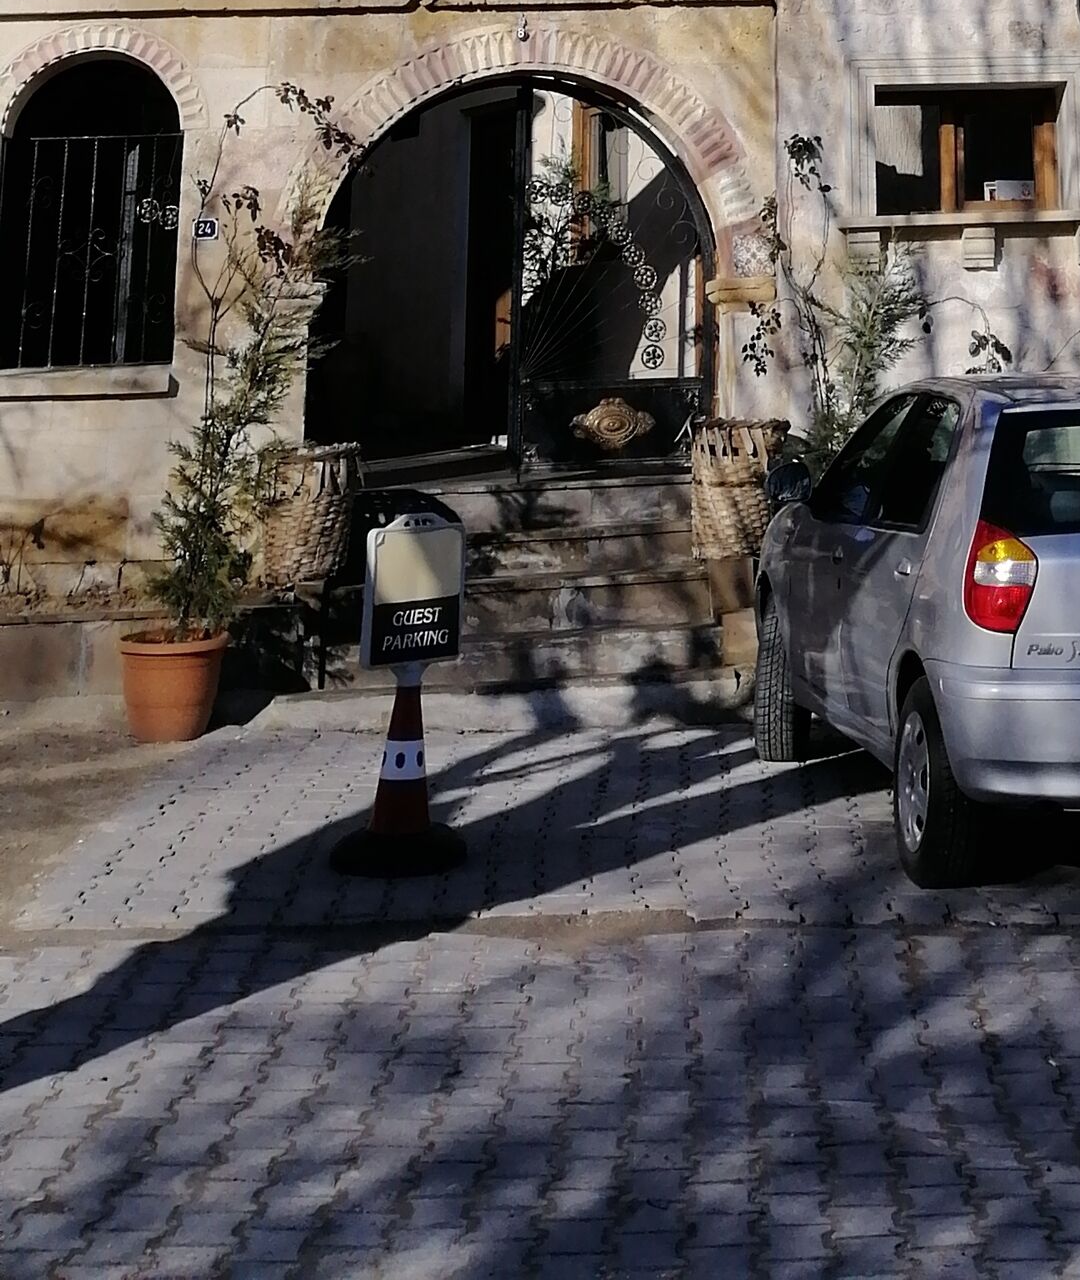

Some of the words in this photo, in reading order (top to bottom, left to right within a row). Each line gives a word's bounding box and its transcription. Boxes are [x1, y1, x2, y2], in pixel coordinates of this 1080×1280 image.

[198, 223, 211, 234] 24
[393, 607, 442, 626] GUEST
[382, 629, 449, 651] PARKING
